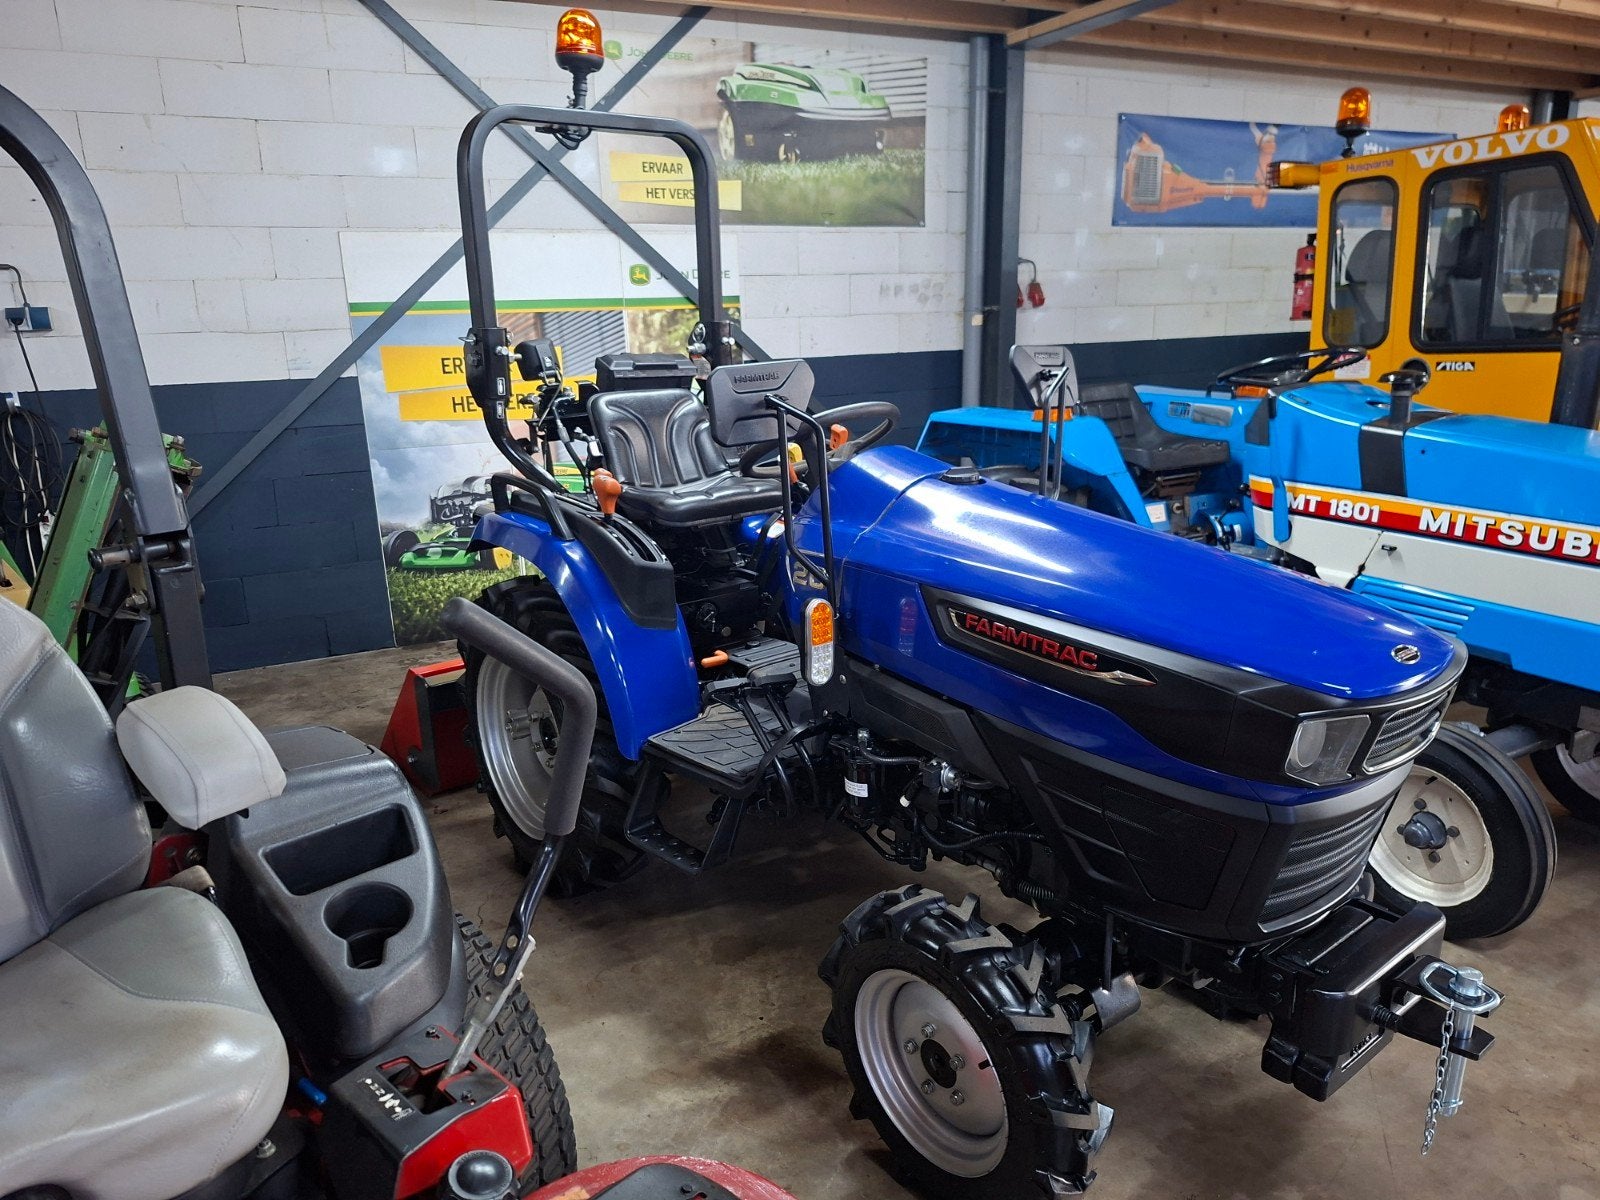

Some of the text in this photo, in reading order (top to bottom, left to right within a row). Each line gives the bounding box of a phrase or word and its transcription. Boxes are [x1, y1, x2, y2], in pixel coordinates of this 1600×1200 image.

[1411, 124, 1570, 169] VOLVO
[642, 161, 683, 174] ERVAAR
[1346, 159, 1394, 172] Husqvarna
[646, 187, 667, 199] HET
[1436, 361, 1475, 371] STIGA
[452, 395, 478, 413] HE
[1287, 492, 1380, 523] MT 1801
[965, 612, 1099, 671] FARMTRAC
